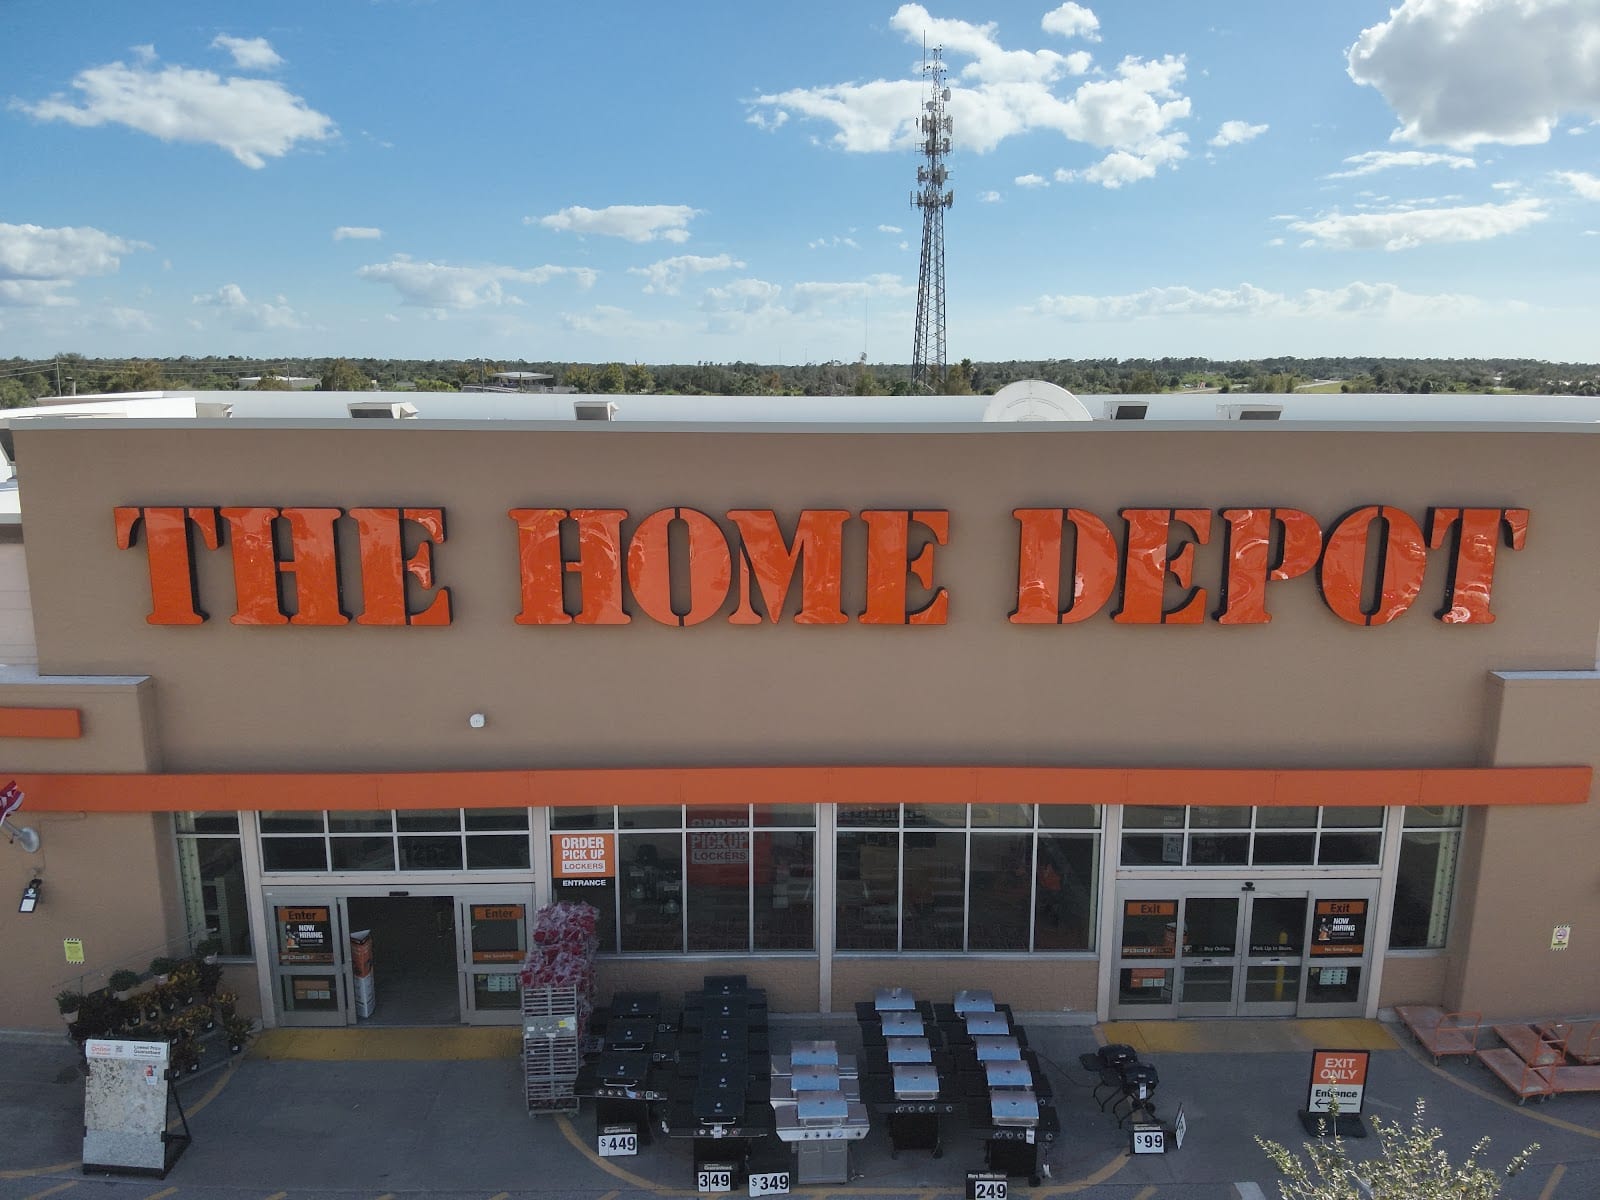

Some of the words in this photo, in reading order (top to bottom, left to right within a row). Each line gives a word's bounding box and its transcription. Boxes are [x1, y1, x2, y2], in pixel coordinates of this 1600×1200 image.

[114, 507, 453, 627] THE
[508, 507, 950, 627] HOME
[1009, 504, 1530, 627] DEPOT
[562, 837, 605, 849] ORDER
[562, 850, 587, 860] PICK
[590, 849, 605, 860] UP
[694, 851, 747, 861] LOCKERS
[562, 879, 607, 887] ENTRANCE
[1140, 904, 1161, 914] Exit
[1330, 903, 1350, 913] Exit
[288, 910, 317, 920] Enter
[485, 909, 513, 919] Enter
[1332, 924, 1356, 932] HIRING
[1324, 1058, 1357, 1069] EXIT
[1320, 1069, 1359, 1080] ONLY
[976, 1183, 1007, 1199] 249
